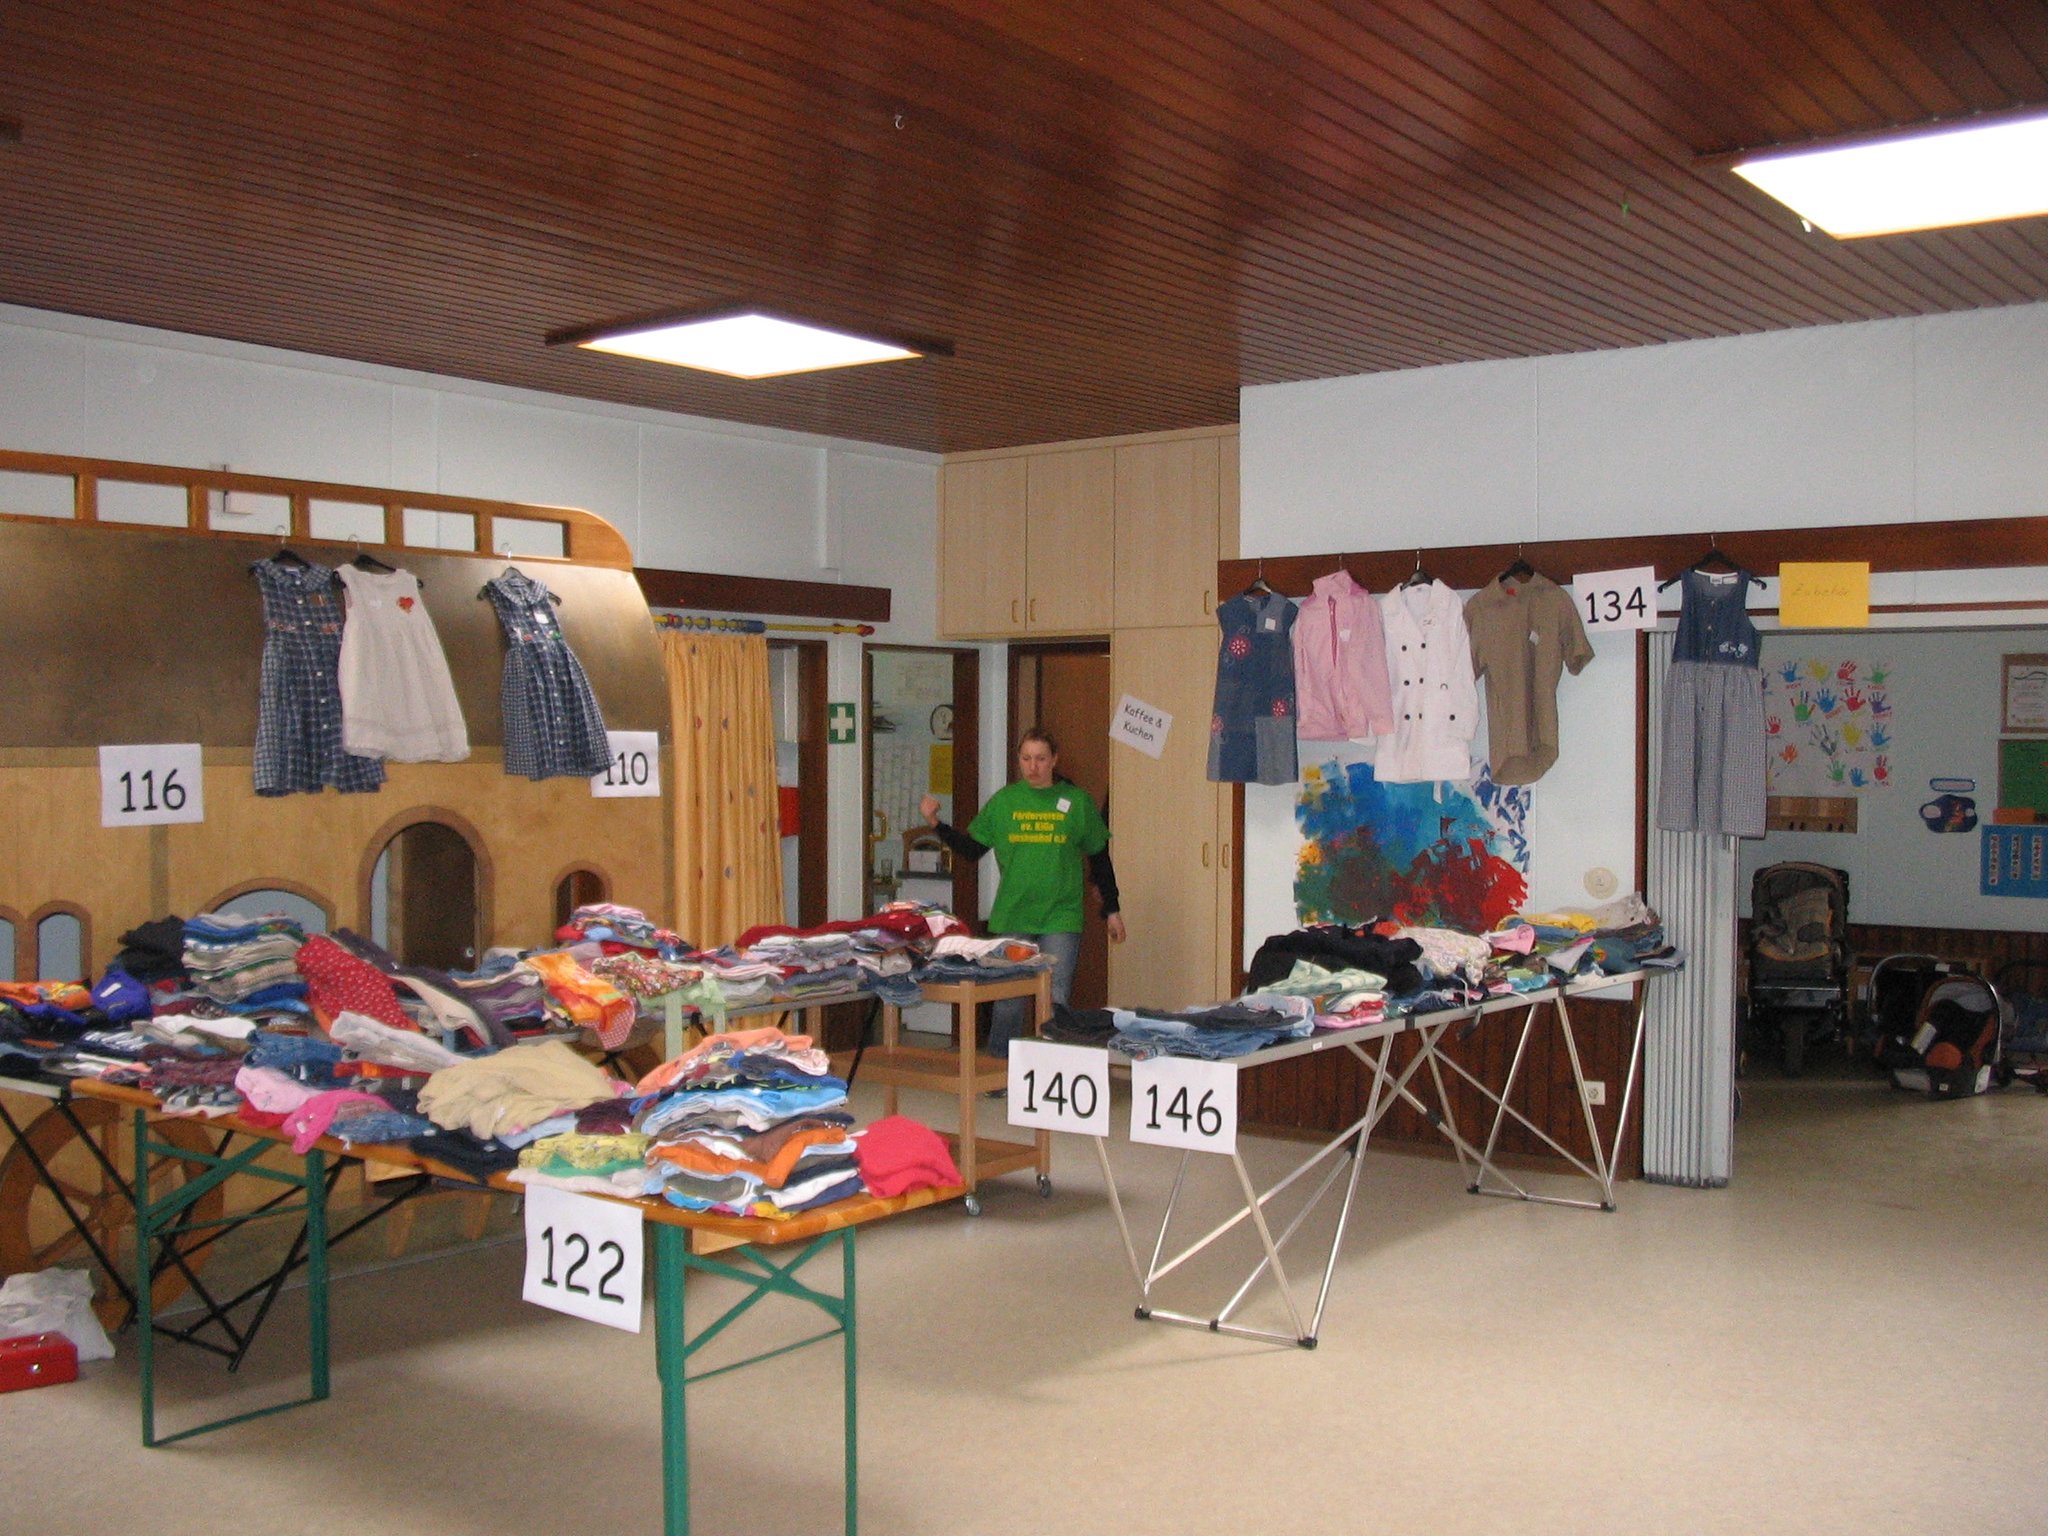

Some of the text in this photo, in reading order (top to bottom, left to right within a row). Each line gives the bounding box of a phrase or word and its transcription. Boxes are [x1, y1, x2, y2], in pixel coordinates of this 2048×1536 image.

[1586, 586, 1647, 624] 134
[1123, 720, 1154, 741] Kuchen
[1124, 703, 1162, 728] Kaffee &
[603, 751, 649, 786] 110
[120, 768, 187, 812] 116
[1022, 1069, 1098, 1119] 140
[1145, 1083, 1223, 1137] 146
[541, 1226, 625, 1305] 122
